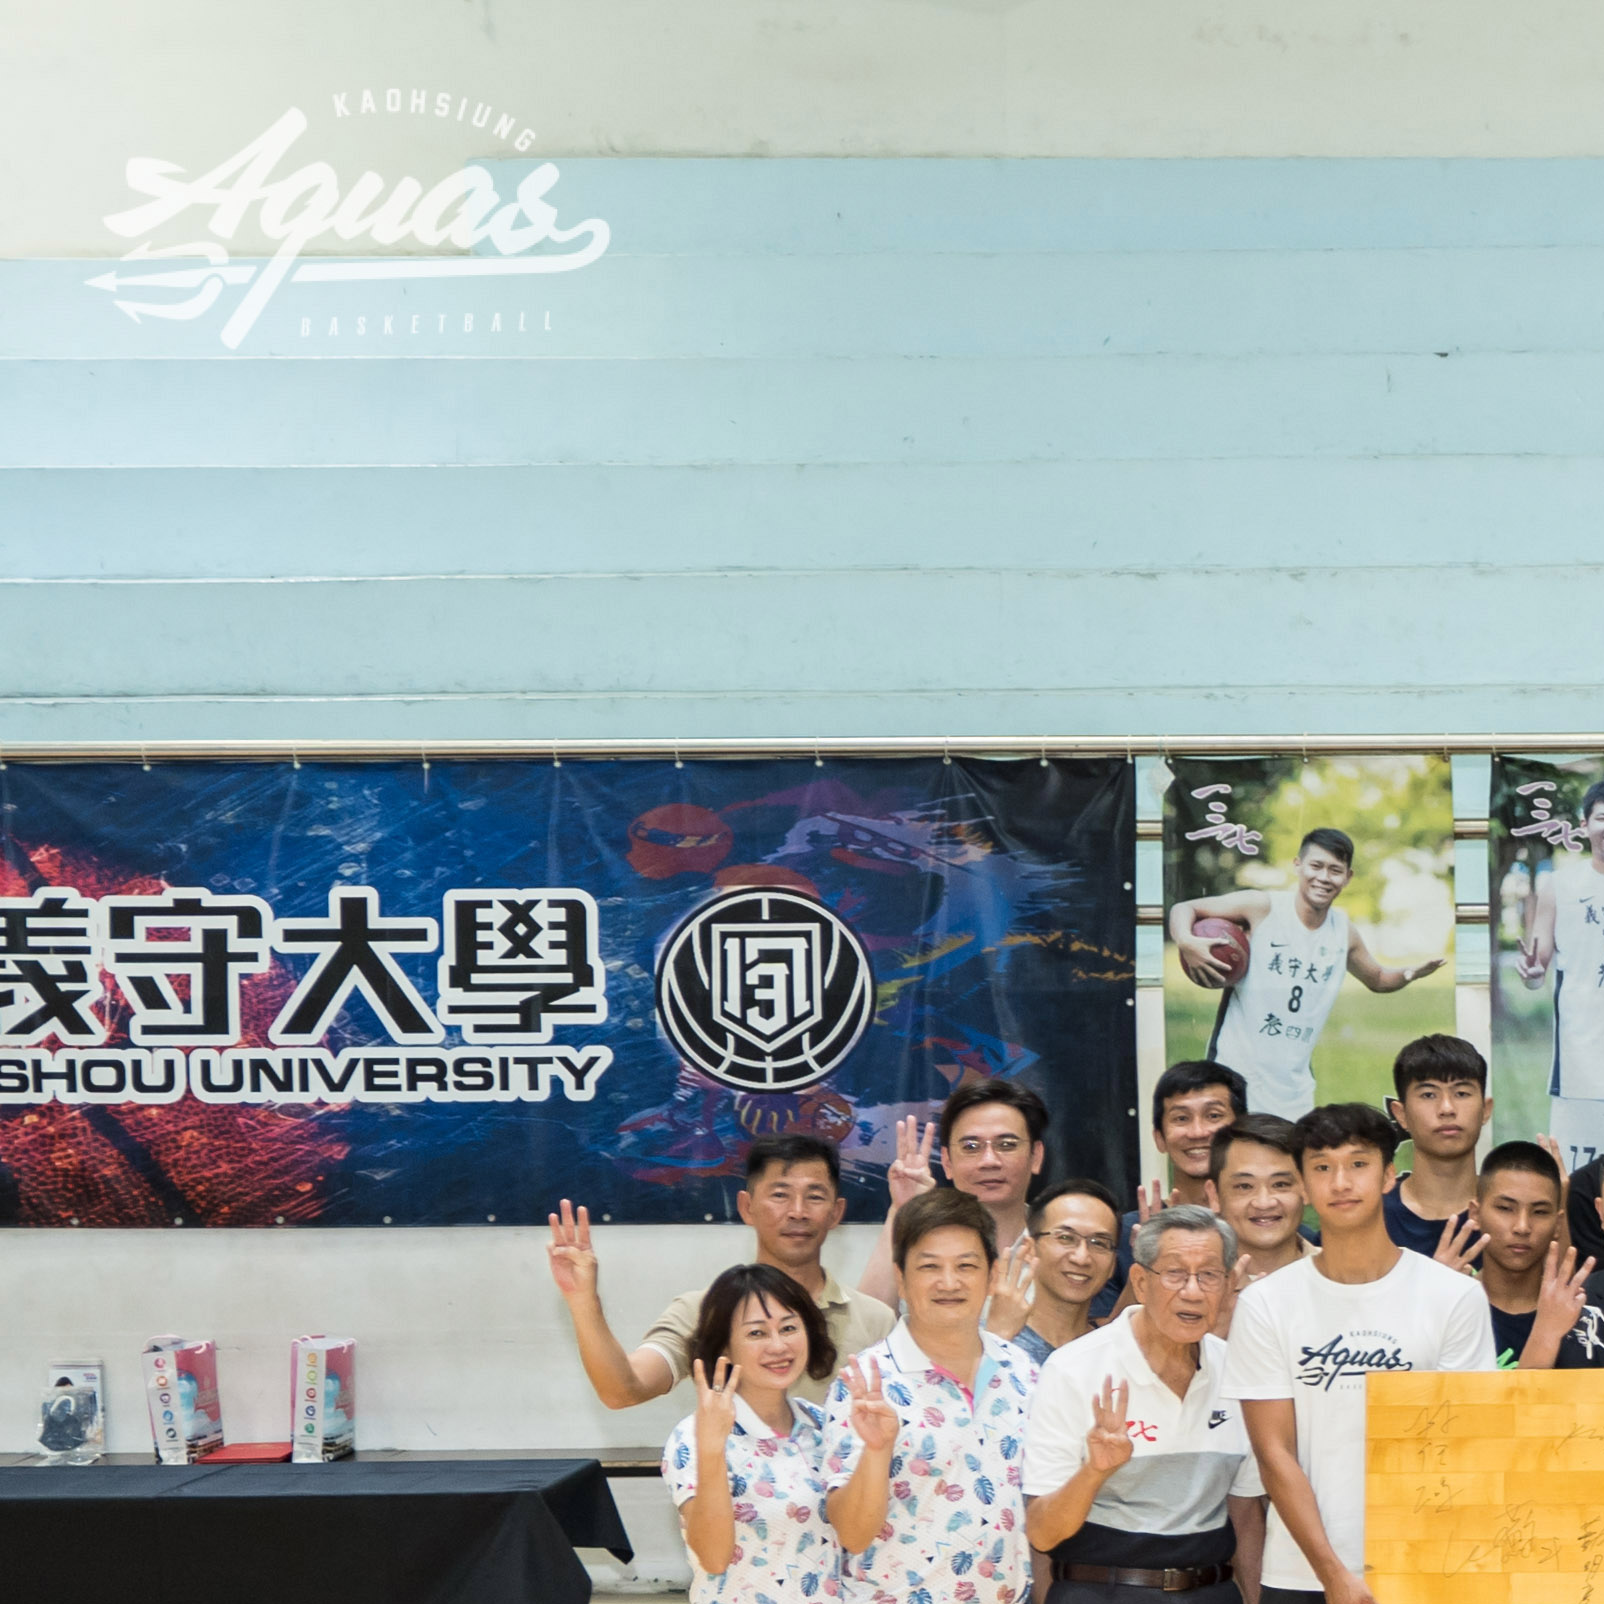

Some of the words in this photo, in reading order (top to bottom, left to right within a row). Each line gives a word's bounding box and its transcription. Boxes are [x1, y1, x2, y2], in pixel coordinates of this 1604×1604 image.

[0, 895, 600, 1036] 義守大學
[1287, 985, 1303, 1013] 8
[200, 1056, 602, 1093] UNIVERSITY
[1349, 1329, 1399, 1345] KAOHSIUNG
[1297, 1334, 1413, 1392] Aquas
